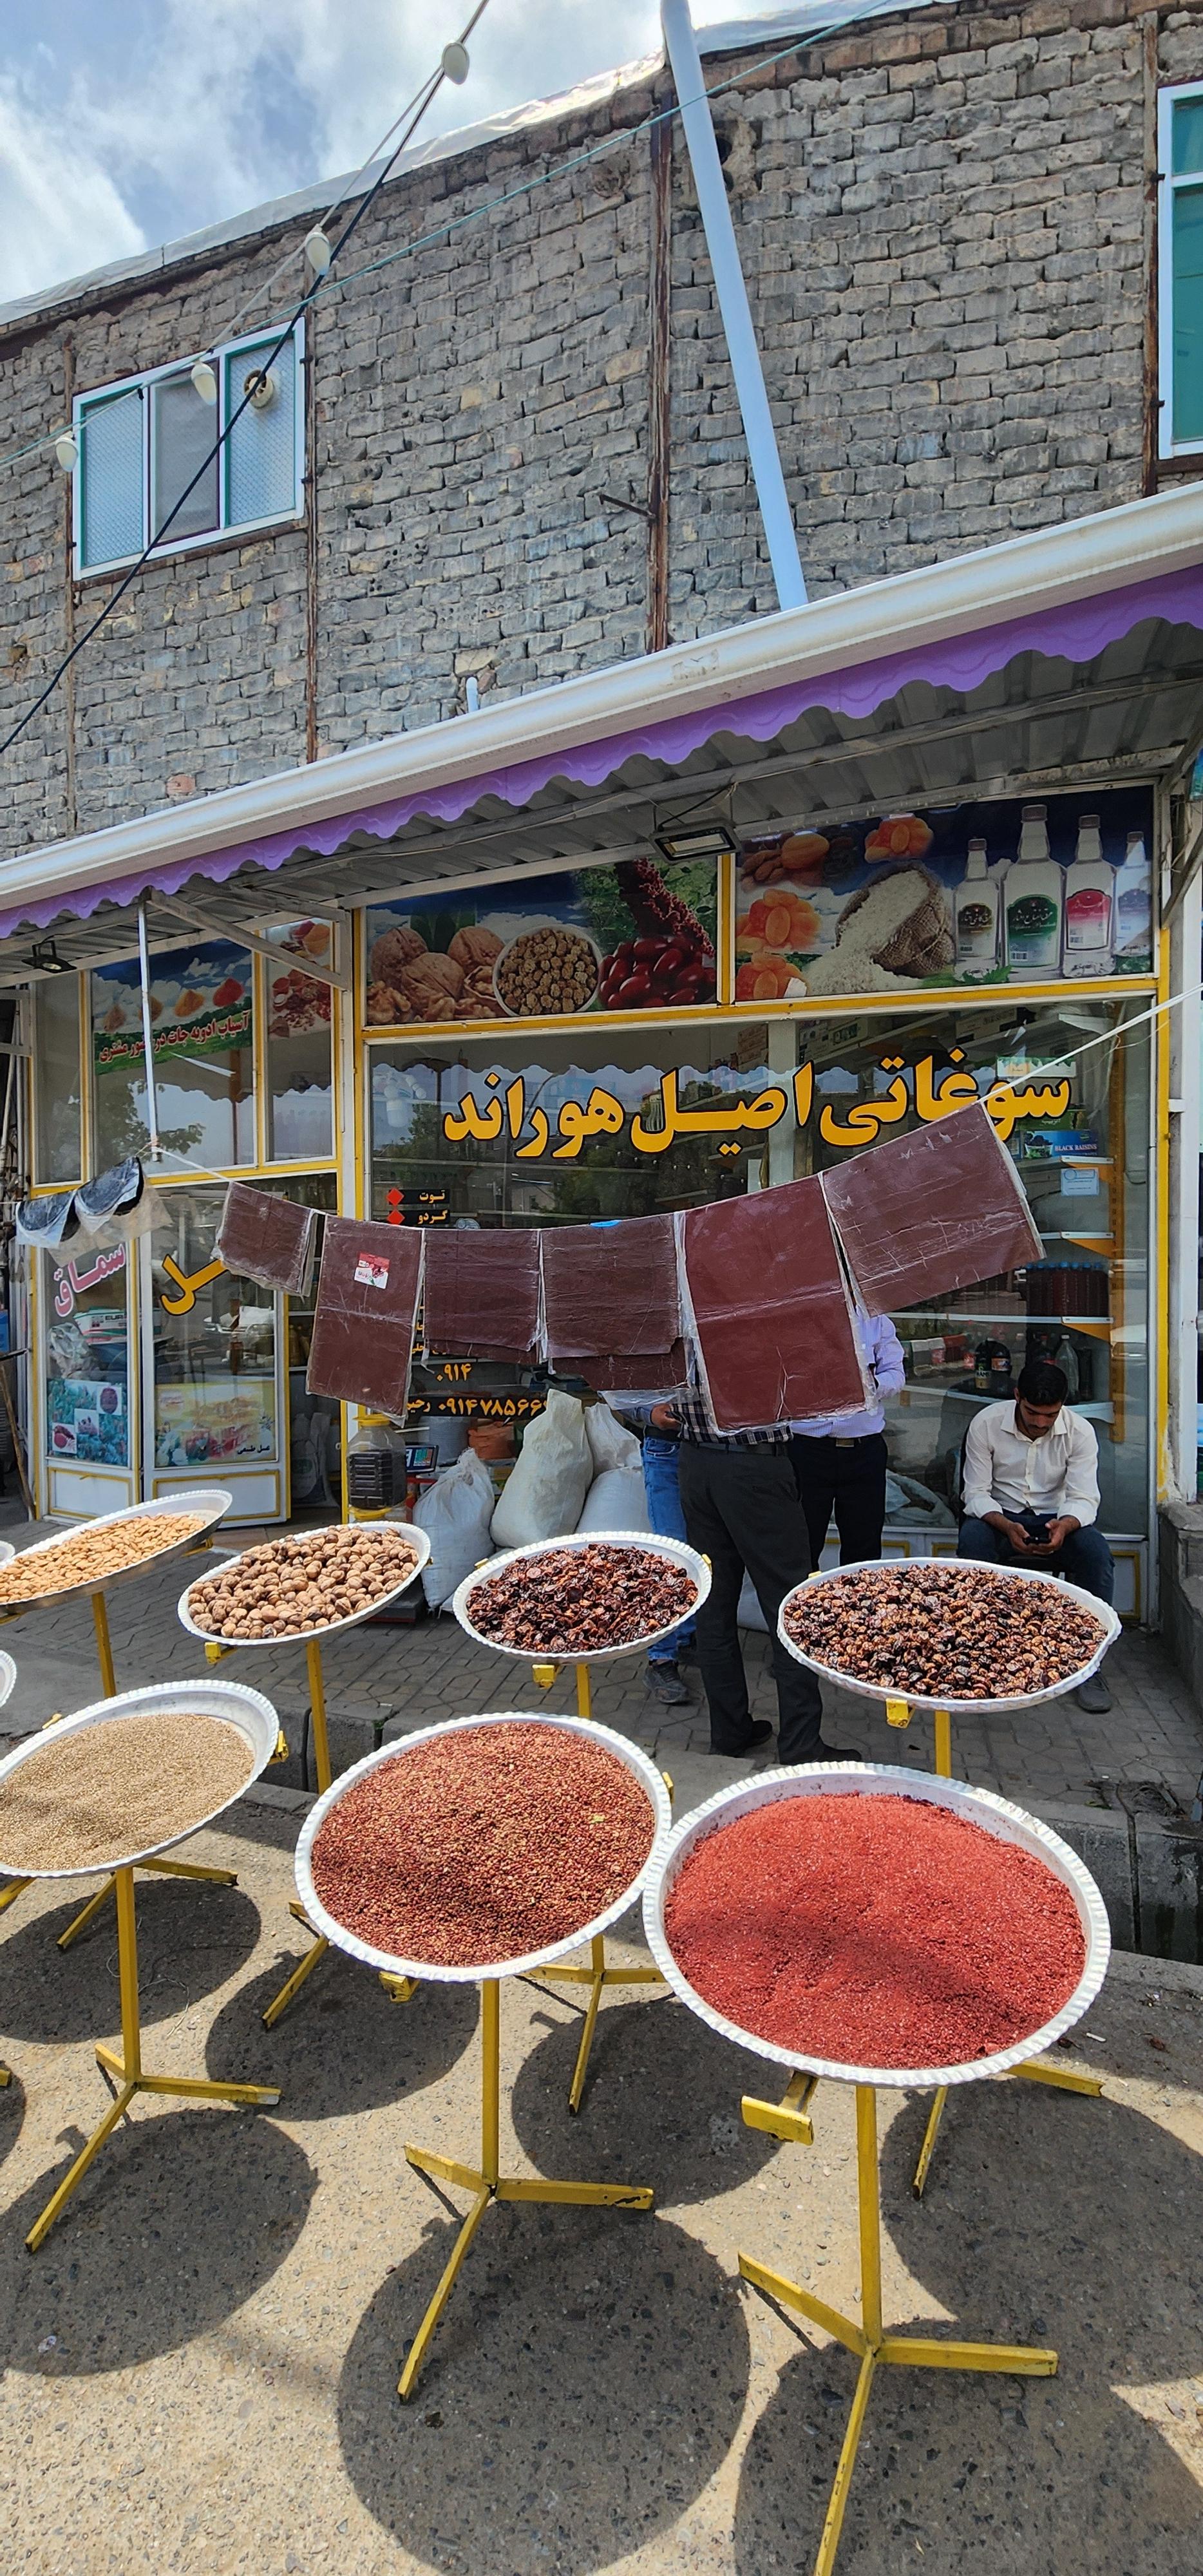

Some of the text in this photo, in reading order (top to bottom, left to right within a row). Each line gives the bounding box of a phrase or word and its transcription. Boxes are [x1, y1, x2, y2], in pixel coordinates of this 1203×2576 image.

[167, 1026, 189, 1047] جات
[190, 1018, 217, 1045] ادویه
[218, 1010, 251, 1039] آسیاب
[99, 1039, 128, 1064] مشتری
[129, 1036, 147, 1059] ضور
[443, 1046, 1072, 1159] سوغاتی اصیل هوراند
[419, 1189, 446, 1204] توت
[417, 1209, 448, 1224] گردو
[54, 1244, 126, 1317] سماق
[436, 1363, 473, 1382] ۰۹۱۴
